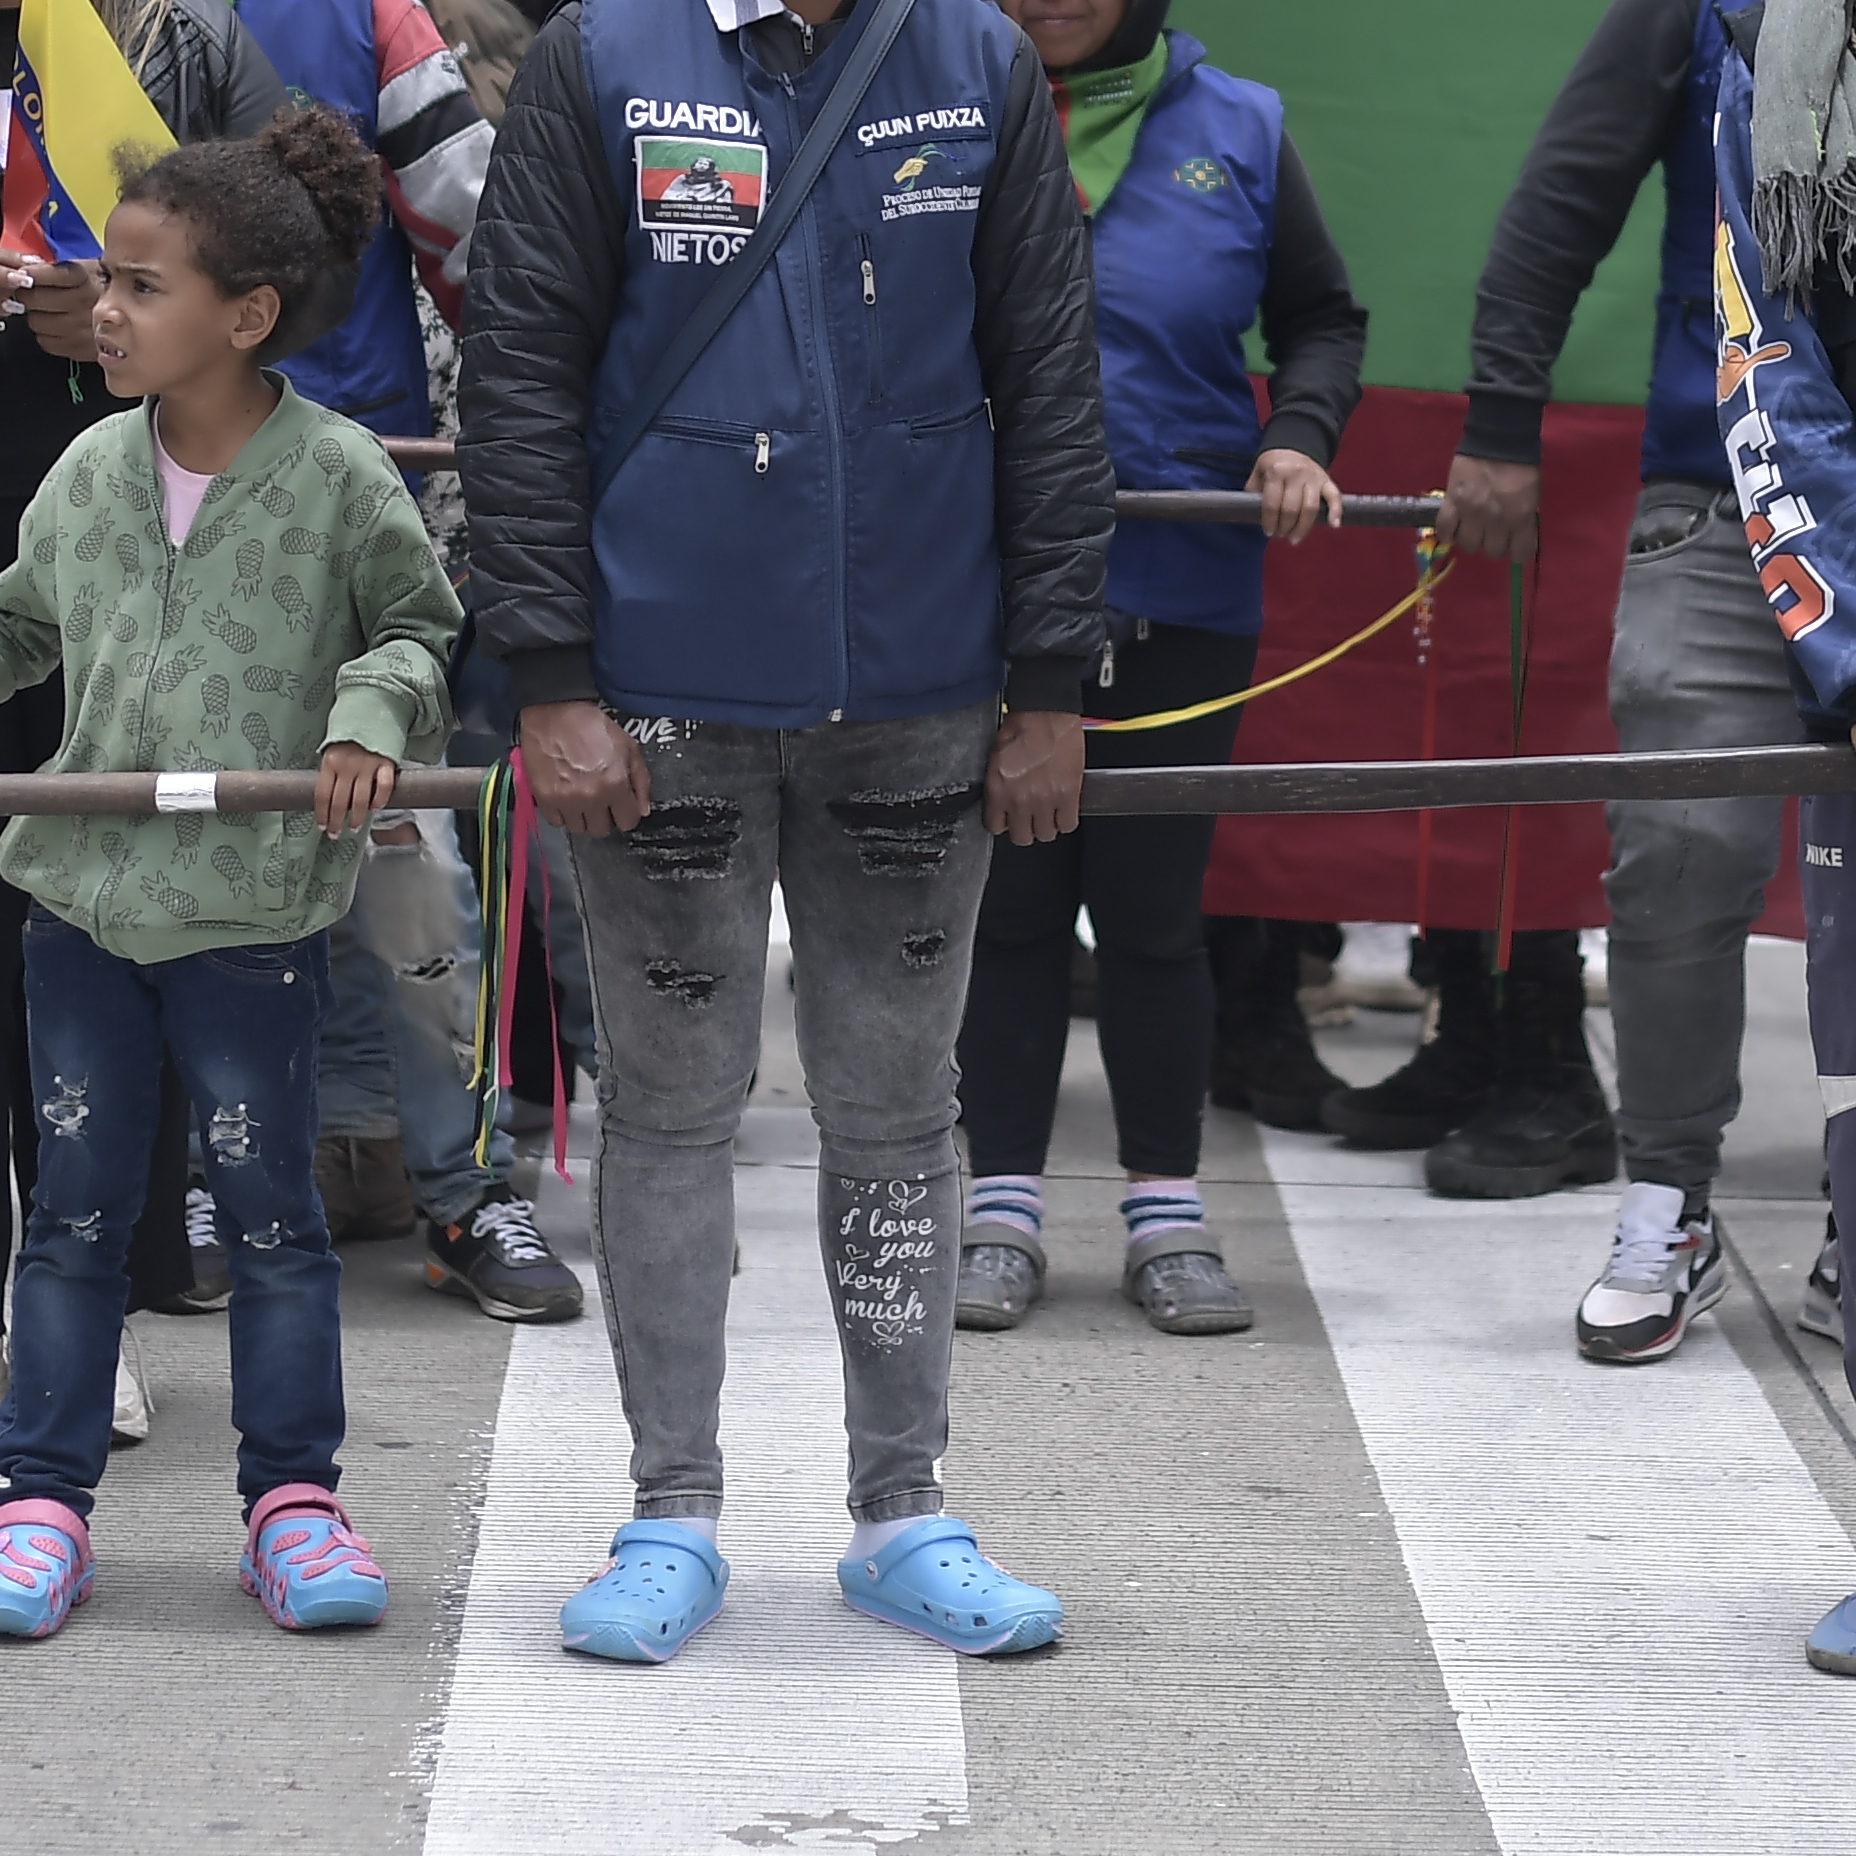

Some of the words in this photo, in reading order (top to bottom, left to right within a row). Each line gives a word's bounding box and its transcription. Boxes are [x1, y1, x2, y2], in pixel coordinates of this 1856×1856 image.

[857, 115, 913, 146] ÇUUN
[916, 106, 986, 131] PUIXZA
[1805, 843, 1844, 868] NIKE
[840, 1207, 861, 1236] I
[868, 1209, 937, 1238] love
[874, 1240, 935, 1269] you
[836, 1259, 904, 1301] Very
[845, 1290, 927, 1320] much
